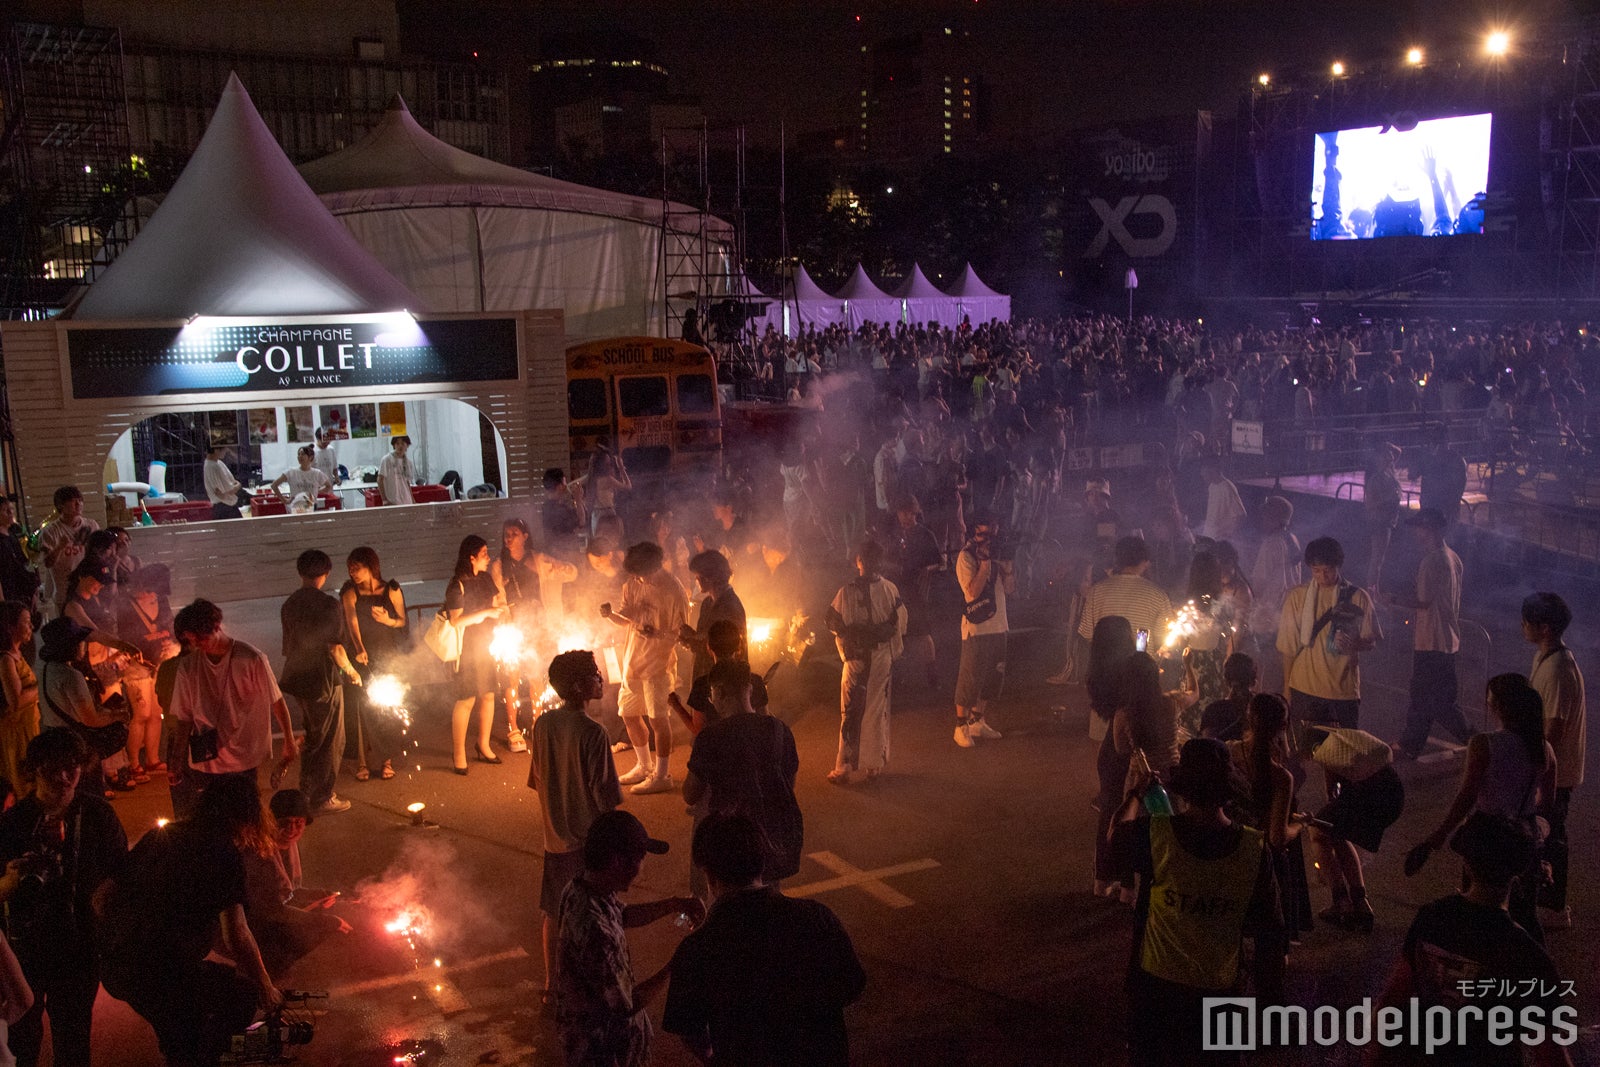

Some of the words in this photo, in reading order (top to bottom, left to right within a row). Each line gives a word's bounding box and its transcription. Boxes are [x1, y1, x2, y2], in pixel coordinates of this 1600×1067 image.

[258, 328, 353, 343] CHAMPAGNE
[236, 343, 377, 374] COLLET
[603, 348, 648, 365] SCHOOL
[652, 347, 675, 363] BUS
[303, 374, 342, 385] FRANCE
